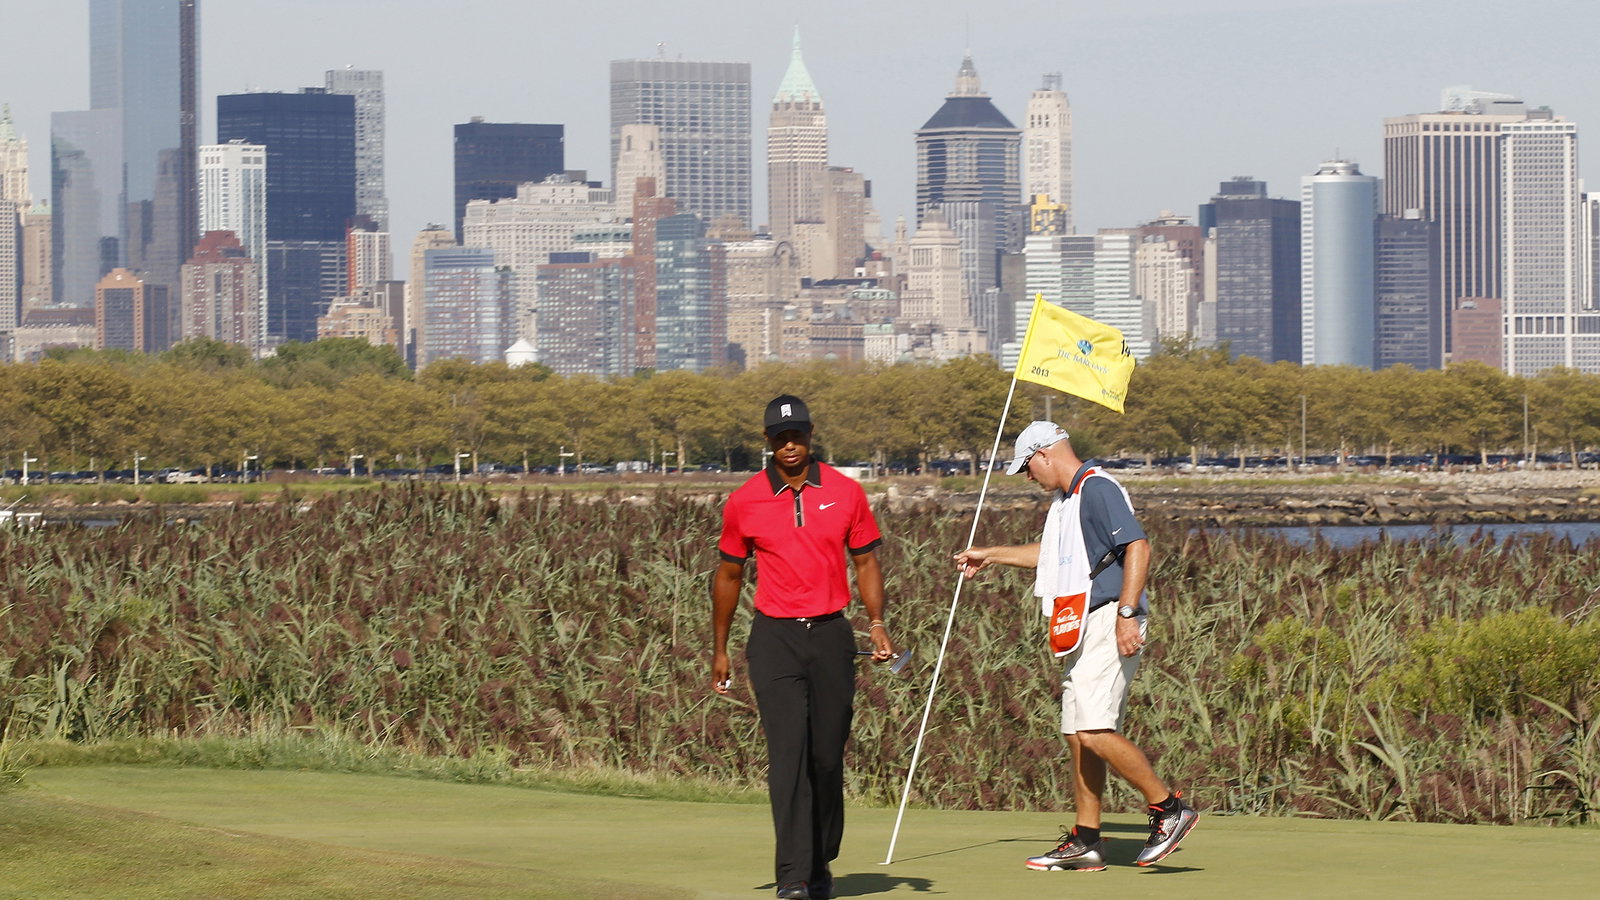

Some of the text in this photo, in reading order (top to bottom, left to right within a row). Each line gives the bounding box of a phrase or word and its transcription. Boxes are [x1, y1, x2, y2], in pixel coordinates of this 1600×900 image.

[1057, 349, 1071, 360] THE
[1121, 339, 1131, 358] 14
[1031, 366, 1050, 378] 2013
